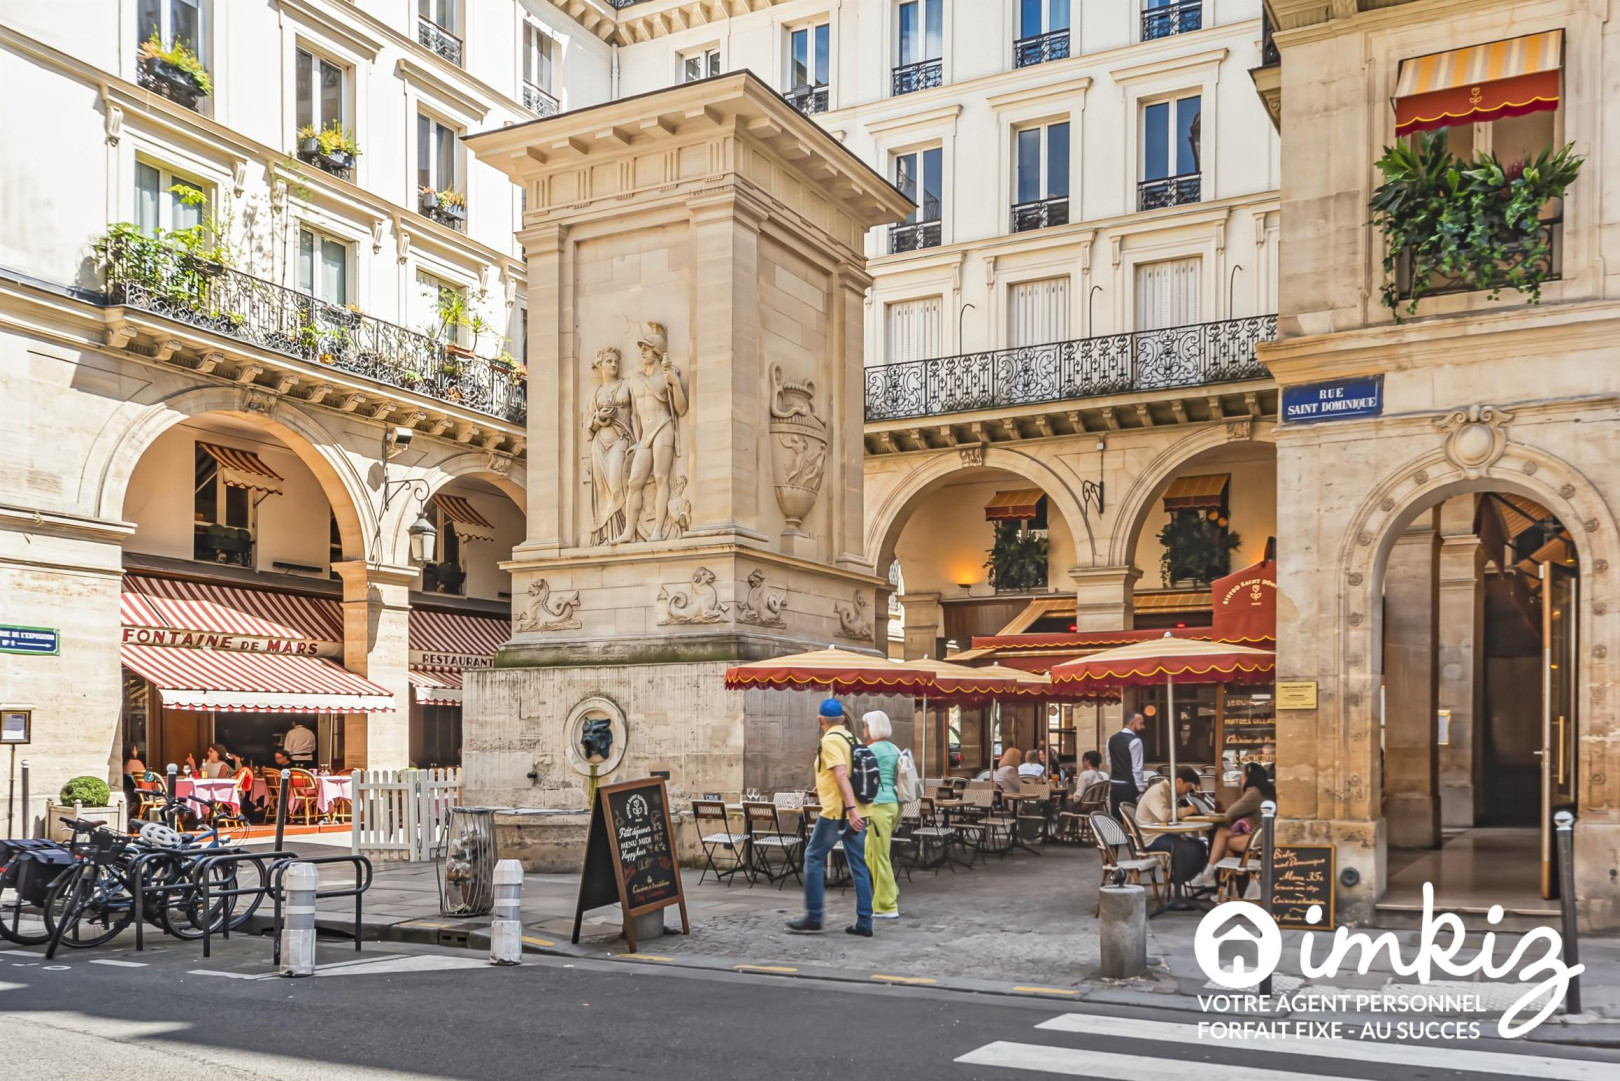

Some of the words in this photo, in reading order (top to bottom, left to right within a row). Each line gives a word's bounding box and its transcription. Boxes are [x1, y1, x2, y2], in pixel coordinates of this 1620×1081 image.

[1319, 388, 1344, 399] RUE
[1288, 403, 1318, 415] SAINT
[1321, 397, 1376, 412] DOMINIQUE
[1222, 585, 1241, 605] BISTRO
[1240, 579, 1261, 588] SAINT
[122, 628, 233, 649] FONTAINE
[240, 641, 259, 651] DE
[266, 639, 318, 655] MARS
[422, 653, 494, 668] RESTAURANT
[620, 840, 637, 850] MENU
[638, 836, 652, 846] MIDI
